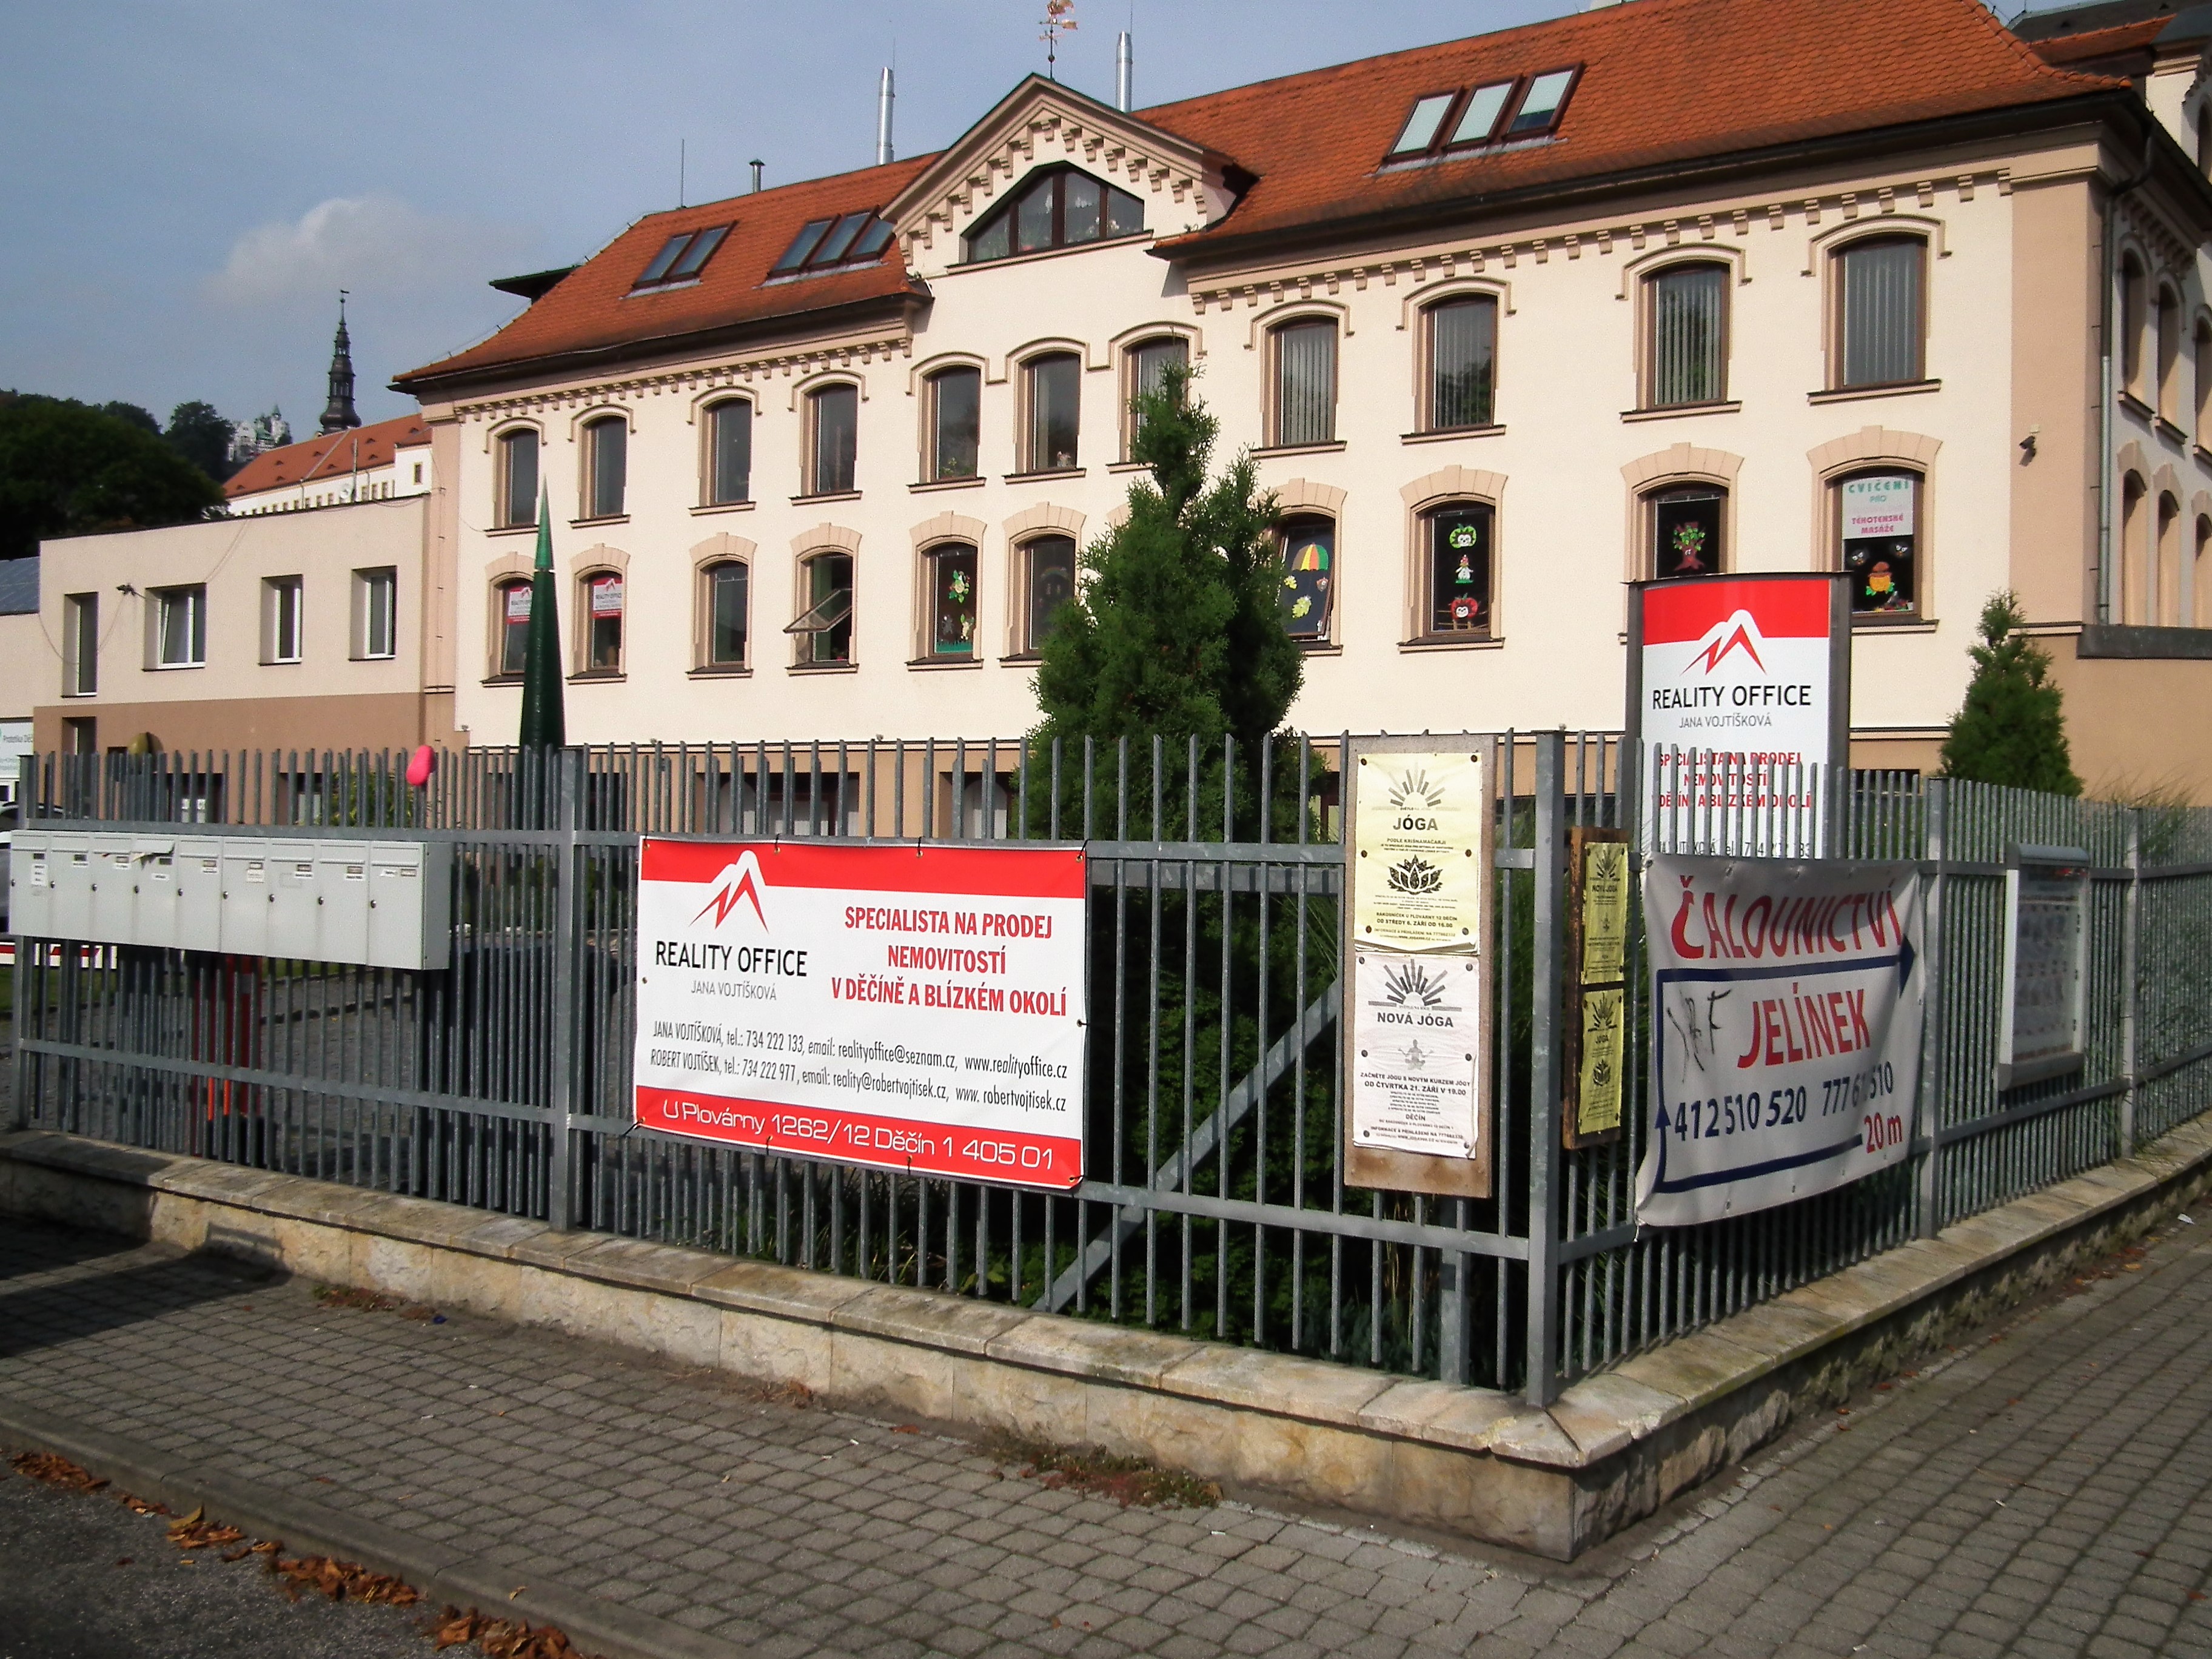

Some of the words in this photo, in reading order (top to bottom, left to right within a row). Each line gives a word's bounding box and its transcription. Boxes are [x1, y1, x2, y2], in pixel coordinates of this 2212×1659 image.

[1652, 686, 1724, 709] REALITY
[1732, 685, 1811, 706] OFFICE
[1679, 716, 1702, 728] JANA
[1704, 712, 1772, 727] VOJTÍŠKOVÁ
[1393, 814, 1438, 831] JÓGA
[845, 906, 950, 934] SPECIALISTA
[955, 911, 976, 935] NA
[982, 913, 1052, 939] PRODEJ
[1671, 875, 1903, 959] ČALOUNICTVÍ
[656, 940, 732, 971] REALITY
[738, 947, 808, 977] OFFICE
[888, 945, 1006, 974] NEMOVITOSTÍ
[691, 980, 716, 996] JANA
[719, 980, 777, 1000] VOJTÍŠKOVÁ
[831, 977, 841, 999] V
[846, 973, 904, 1004] DĚČÍNĚ
[908, 983, 920, 1005] A
[925, 979, 1004, 1012] BLÍZKÉM
[1010, 987, 1067, 1016] OKOLÍ
[1377, 1012, 1413, 1025] NOVÁ
[1417, 1013, 1453, 1027] JÓGA
[1737, 982, 1871, 1068] JELÍNEK
[652, 1021, 674, 1039] JANA
[675, 1021, 724, 1047] VOJTÍŠKOVÁ,
[727, 1031, 744, 1047] tel.:
[746, 1030, 763, 1048] 734
[767, 1032, 784, 1050] 222
[788, 1034, 806, 1056] 133,
[808, 1037, 836, 1057] email:
[839, 1038, 958, 1071] realityoffice@seznam.cz,
[965, 1054, 1067, 1079] www.realityoffice.cz
[650, 1048, 681, 1068] ROBERT
[683, 1050, 722, 1076] VOJTÍŠEK,
[725, 1056, 739, 1075] tel.:
[742, 1058, 758, 1077] 734
[760, 1060, 776, 1080] 222
[802, 1067, 831, 1086] email:
[834, 1068, 949, 1102] reality@robertvojtisek.cz,
[984, 1085, 1066, 1111] robertvojtisek.cz
[1376, 1081, 1409, 1090] ČTVRTKA
[1675, 1098, 1720, 1141] 412
[1724, 1092, 1760, 1134] 510
[1766, 1085, 1806, 1128] 520
[663, 1099, 679, 1119] U
[682, 1102, 765, 1135] Plovárny
[771, 1113, 870, 1147] 1262/12
[875, 1127, 934, 1155] Děčín
[942, 1136, 953, 1158] 1
[962, 1139, 1016, 1165] 405
[1021, 1146, 1053, 1170] 01
[1864, 1112, 1884, 1153] 20
[1887, 1115, 1902, 1145] m
